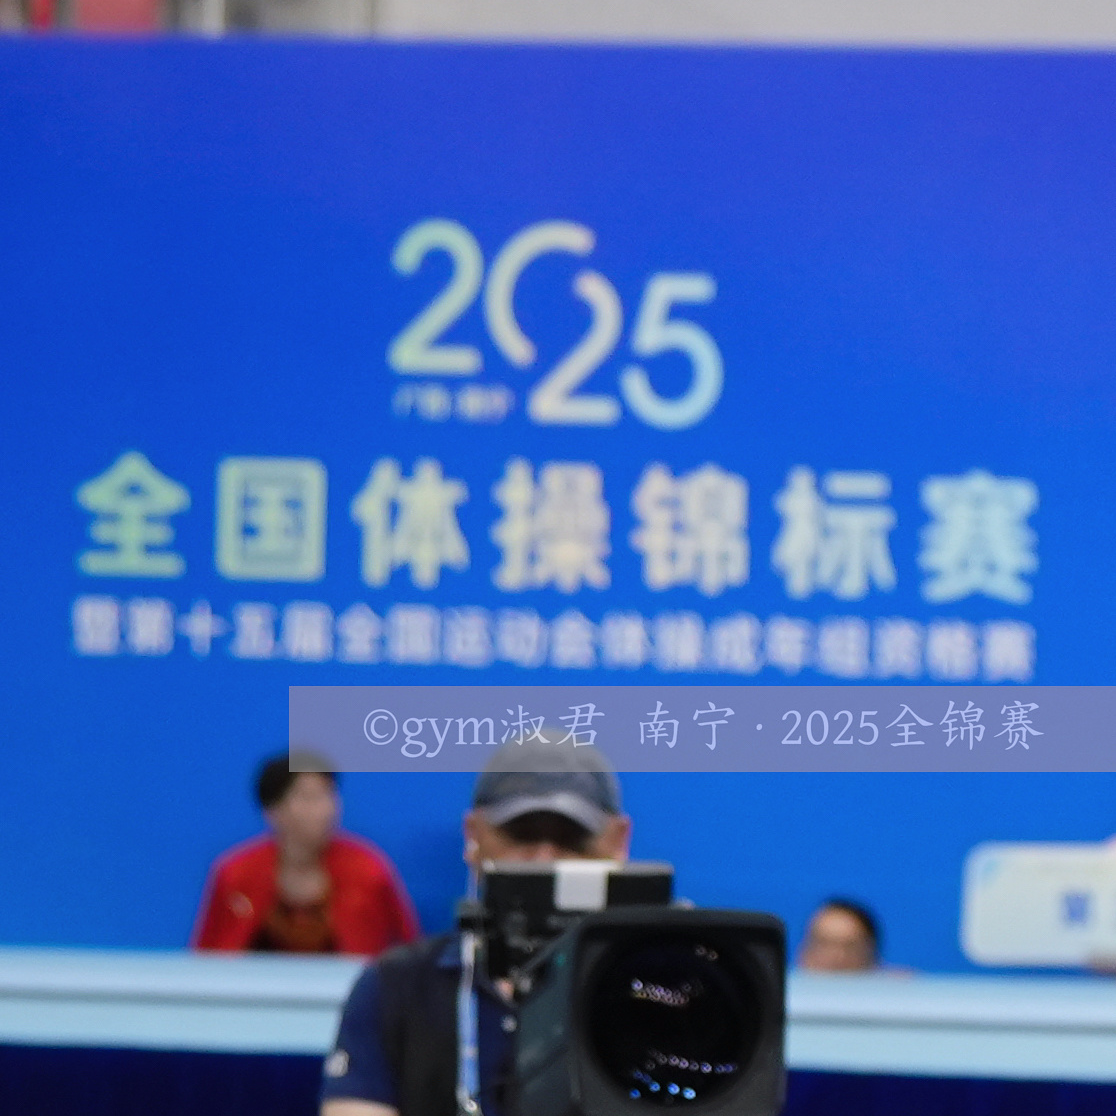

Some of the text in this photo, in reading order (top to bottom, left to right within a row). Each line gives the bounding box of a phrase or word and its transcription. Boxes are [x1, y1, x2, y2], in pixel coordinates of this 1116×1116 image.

[391, 220, 724, 431] 2025
[76, 452, 1040, 605] 全国体操锦标赛
